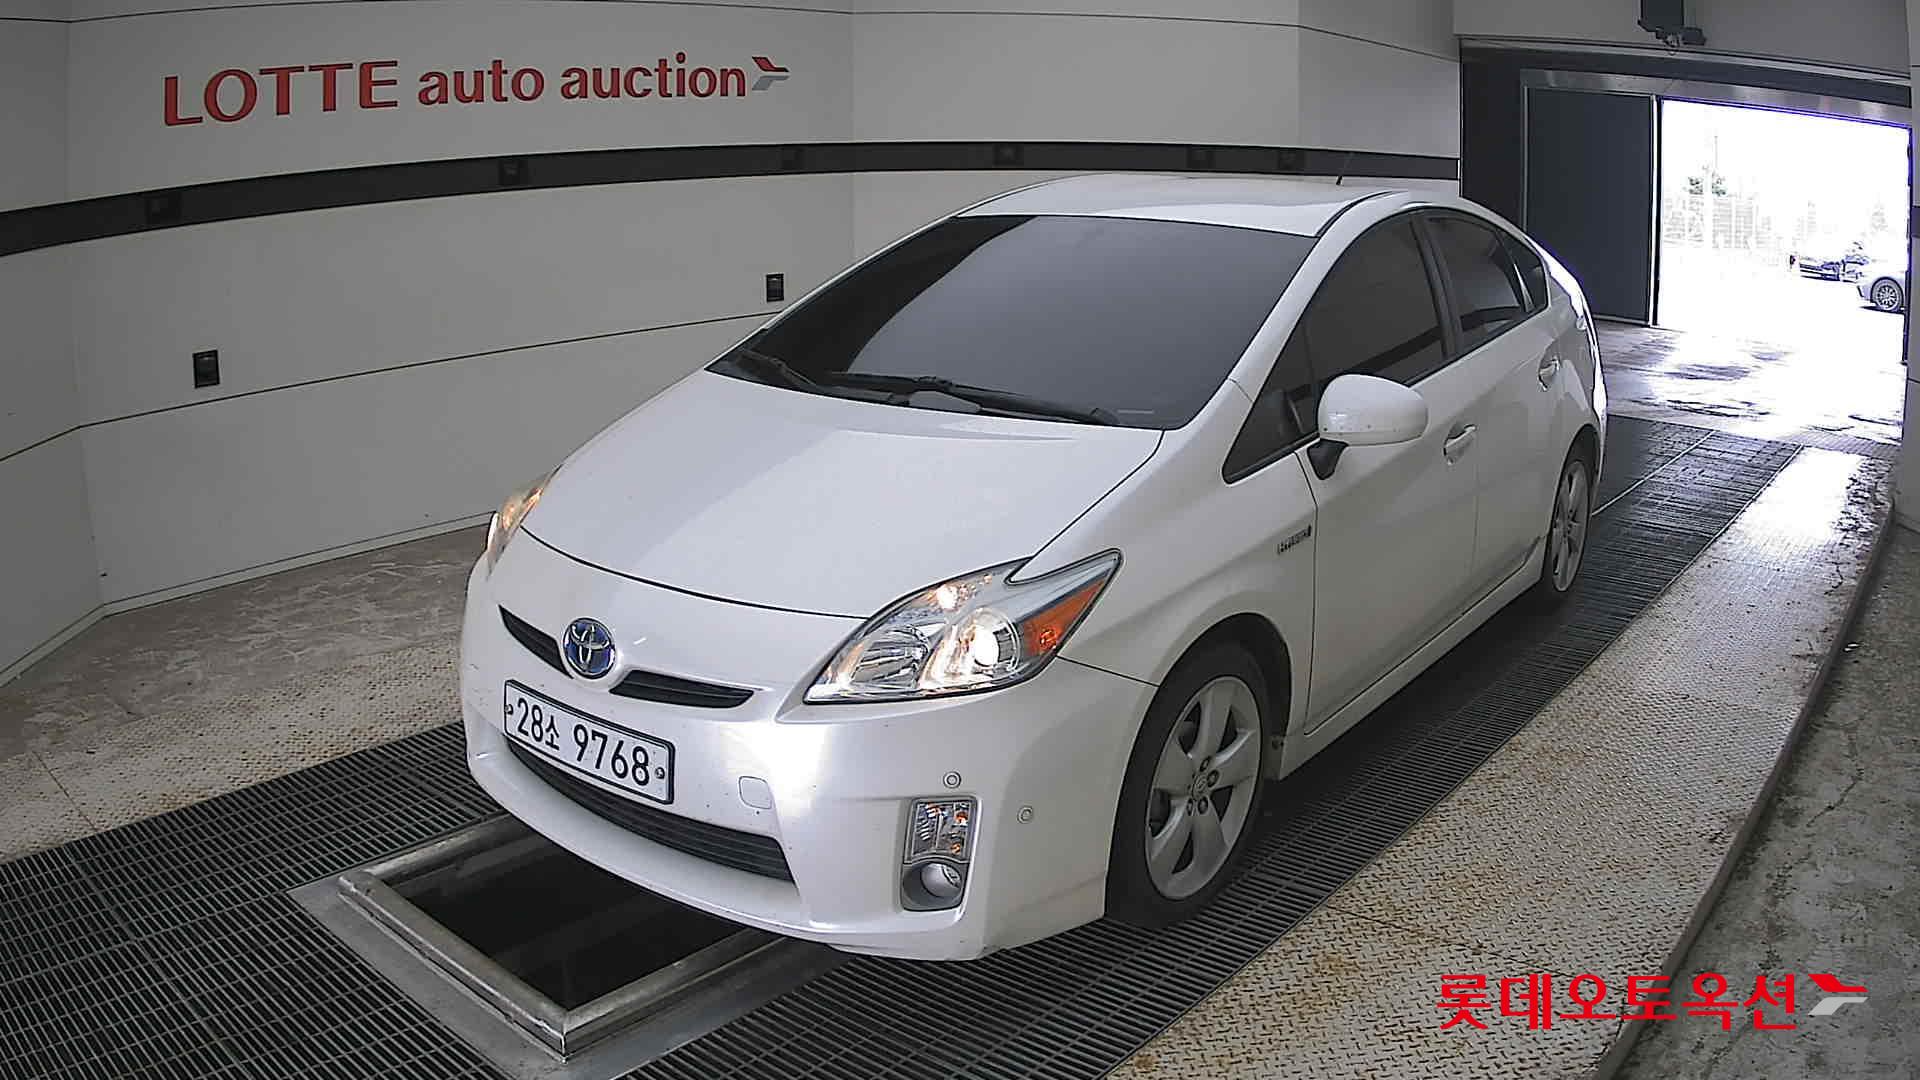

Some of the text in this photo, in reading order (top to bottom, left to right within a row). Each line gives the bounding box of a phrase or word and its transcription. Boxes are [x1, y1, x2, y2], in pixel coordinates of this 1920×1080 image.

[163, 51, 747, 126] LOTTE auto auction
[517, 697, 650, 786] 28소 9768
